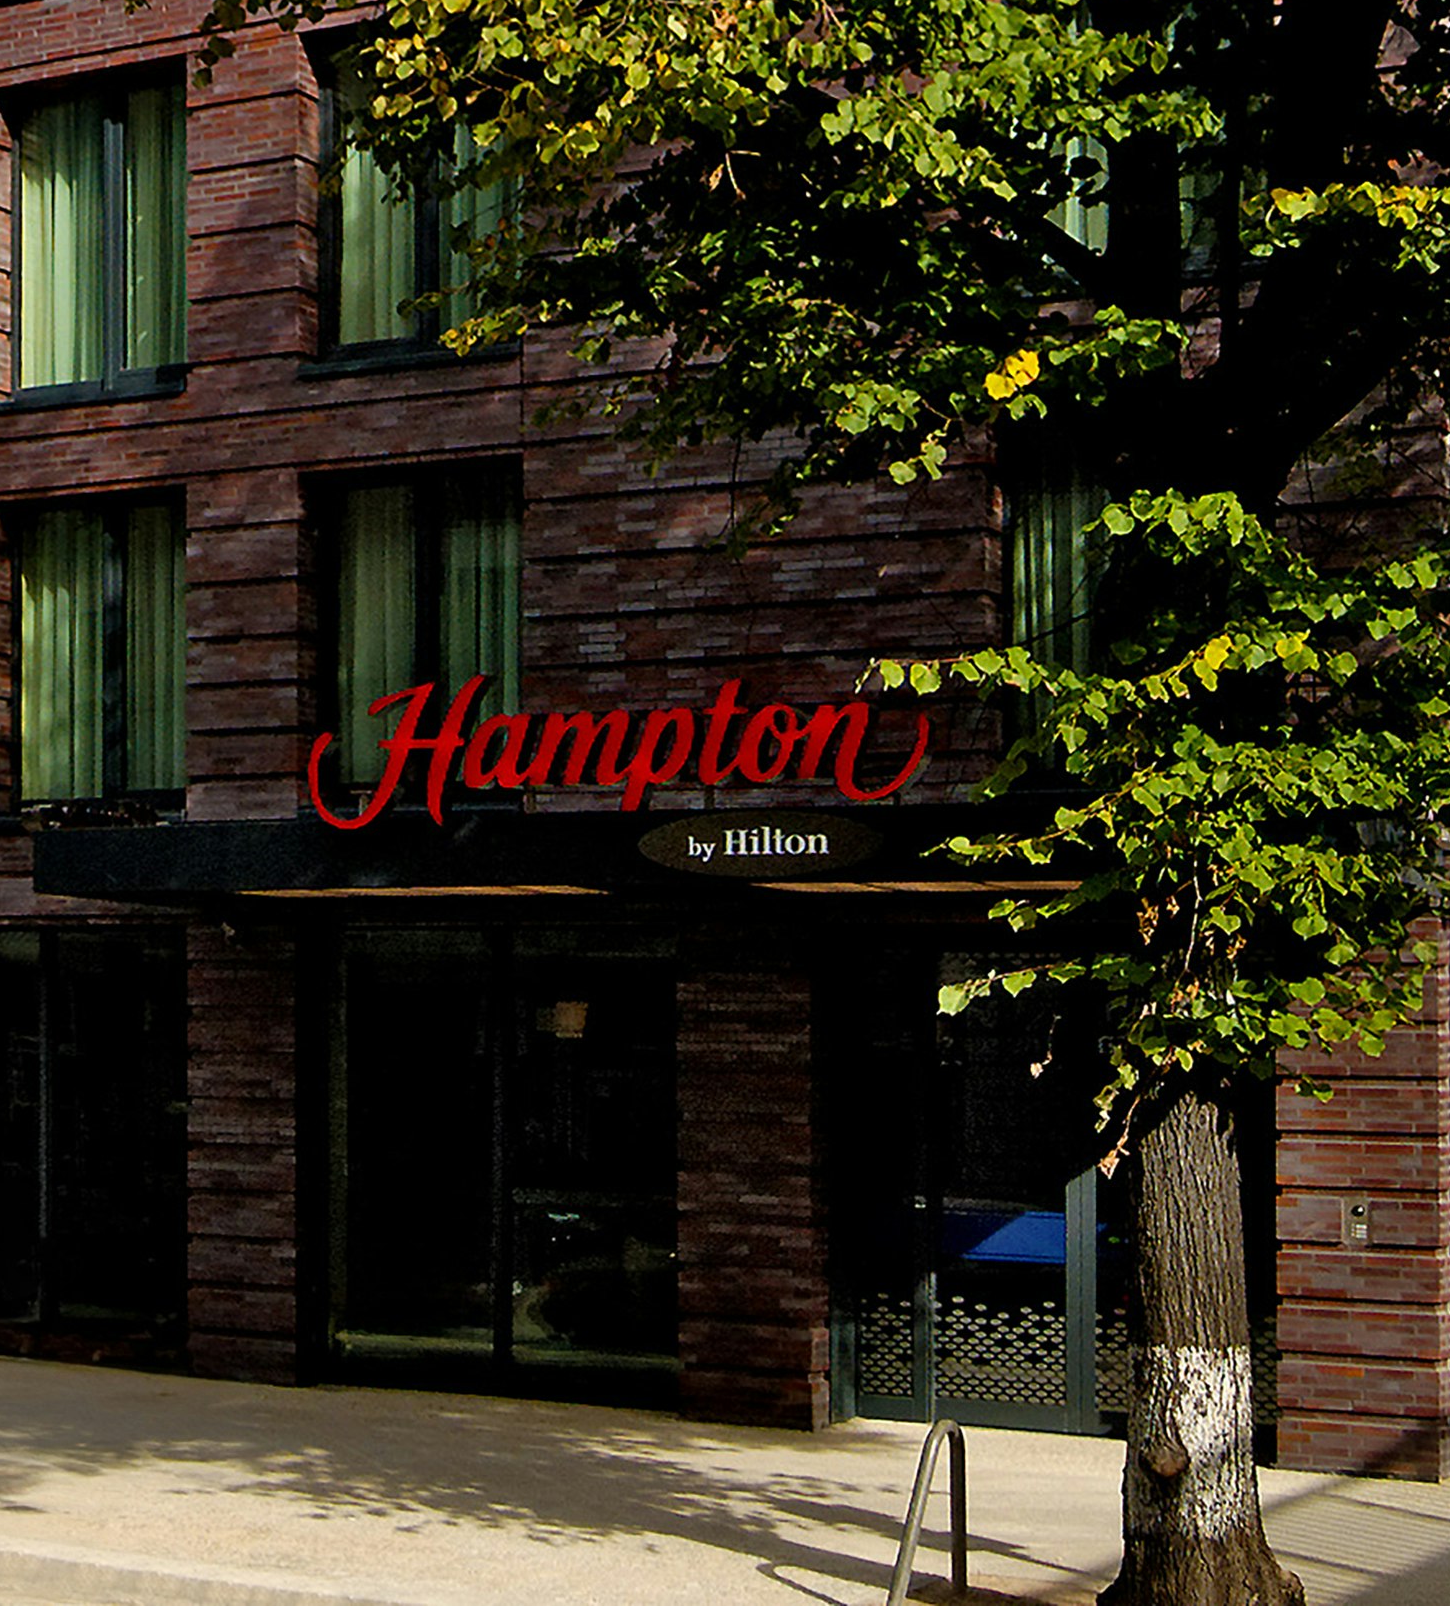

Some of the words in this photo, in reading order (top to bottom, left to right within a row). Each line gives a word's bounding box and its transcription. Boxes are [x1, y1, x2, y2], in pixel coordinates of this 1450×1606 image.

[307, 674, 929, 830] Hampton
[688, 836, 716, 862] by
[723, 827, 830, 856] Hilton
